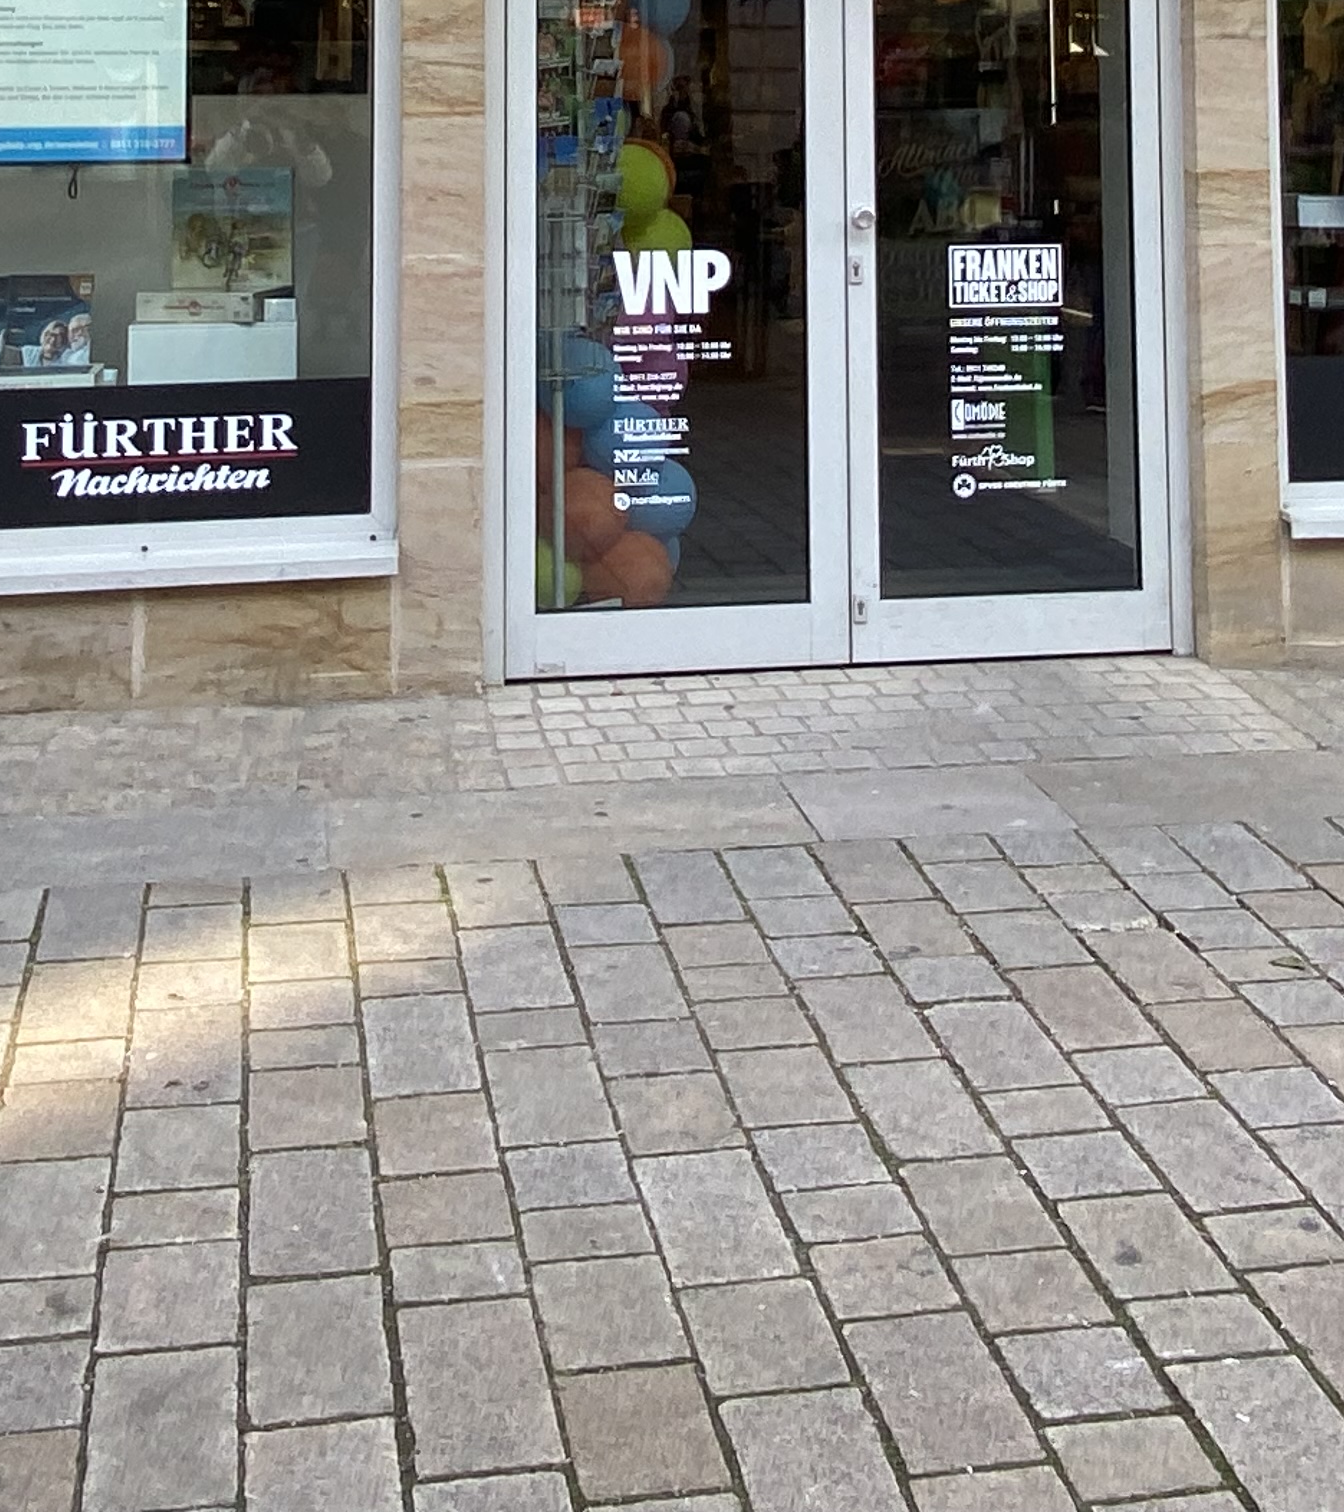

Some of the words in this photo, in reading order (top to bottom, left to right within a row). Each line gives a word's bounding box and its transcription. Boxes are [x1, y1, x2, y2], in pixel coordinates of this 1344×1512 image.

[953, 247, 1057, 281] FRANKEN
[612, 249, 732, 316] VNP
[953, 280, 1058, 304] TICKET&SHOP
[20, 412, 298, 463] FÜRTHER
[613, 416, 690, 435] FÜRTHER
[612, 448, 641, 464] NZ
[951, 453, 988, 468] Fürth
[1003, 452, 1036, 468] Shop
[50, 464, 270, 498] Nachrichten
[614, 468, 660, 486] NN.de
